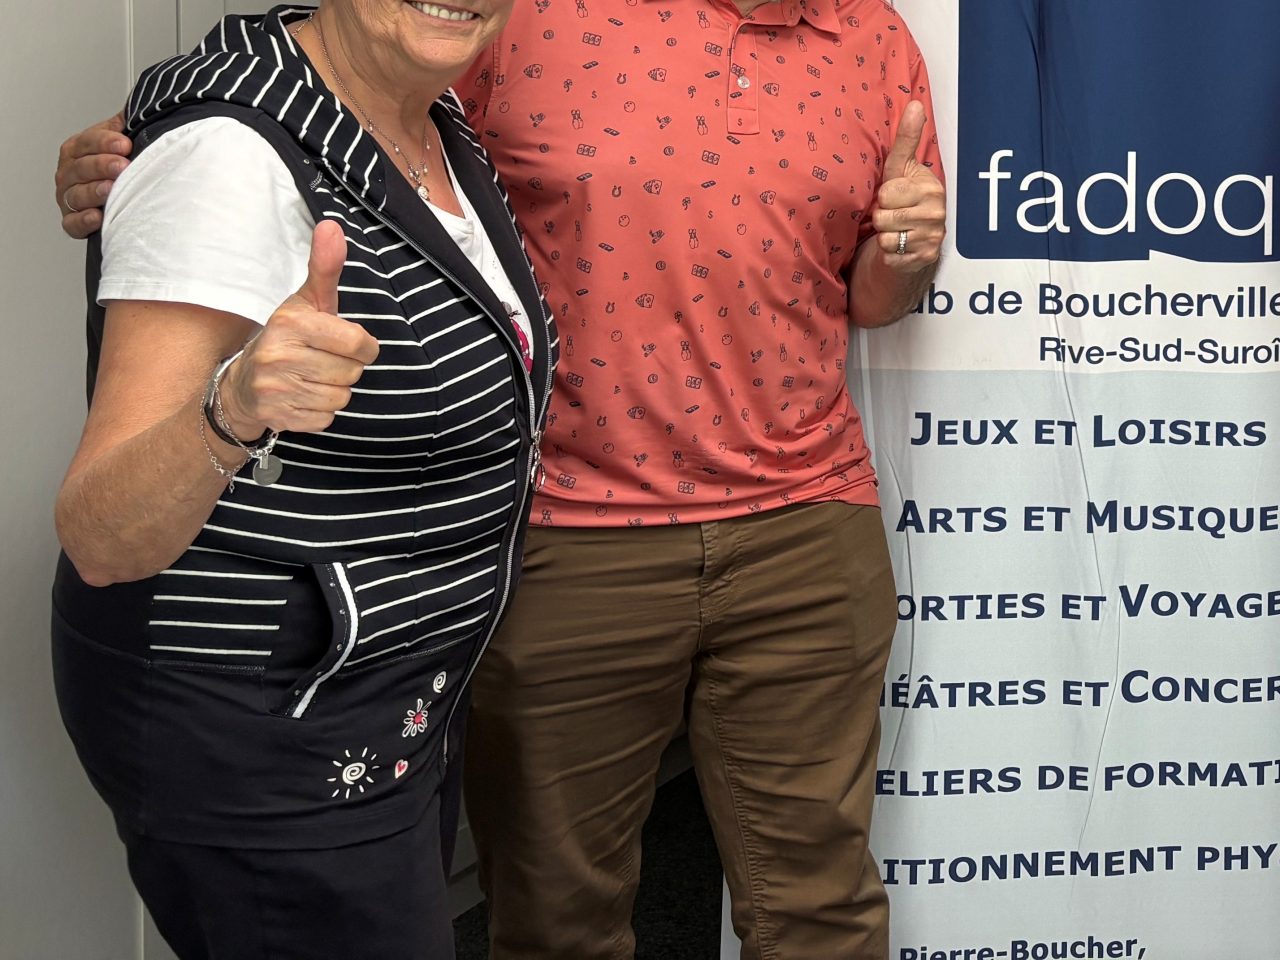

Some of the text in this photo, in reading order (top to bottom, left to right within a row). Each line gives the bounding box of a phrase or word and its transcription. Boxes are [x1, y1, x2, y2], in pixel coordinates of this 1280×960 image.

[978, 149, 1274, 257] fadoq
[968, 283, 1023, 315] de
[910, 411, 1267, 448] JEUX ET LOISIRS
[895, 499, 1279, 539] ARTS ET MUSIQUE
[896, 593, 1045, 622] ORTIES
[1061, 593, 1107, 621] ET
[880, 673, 1046, 709] ÉÂTRES
[1062, 679, 1110, 707] ET
[874, 766, 1022, 797] ELIERS
[1038, 765, 1089, 792] DE
[882, 845, 1182, 886] ITIONNEMENT
